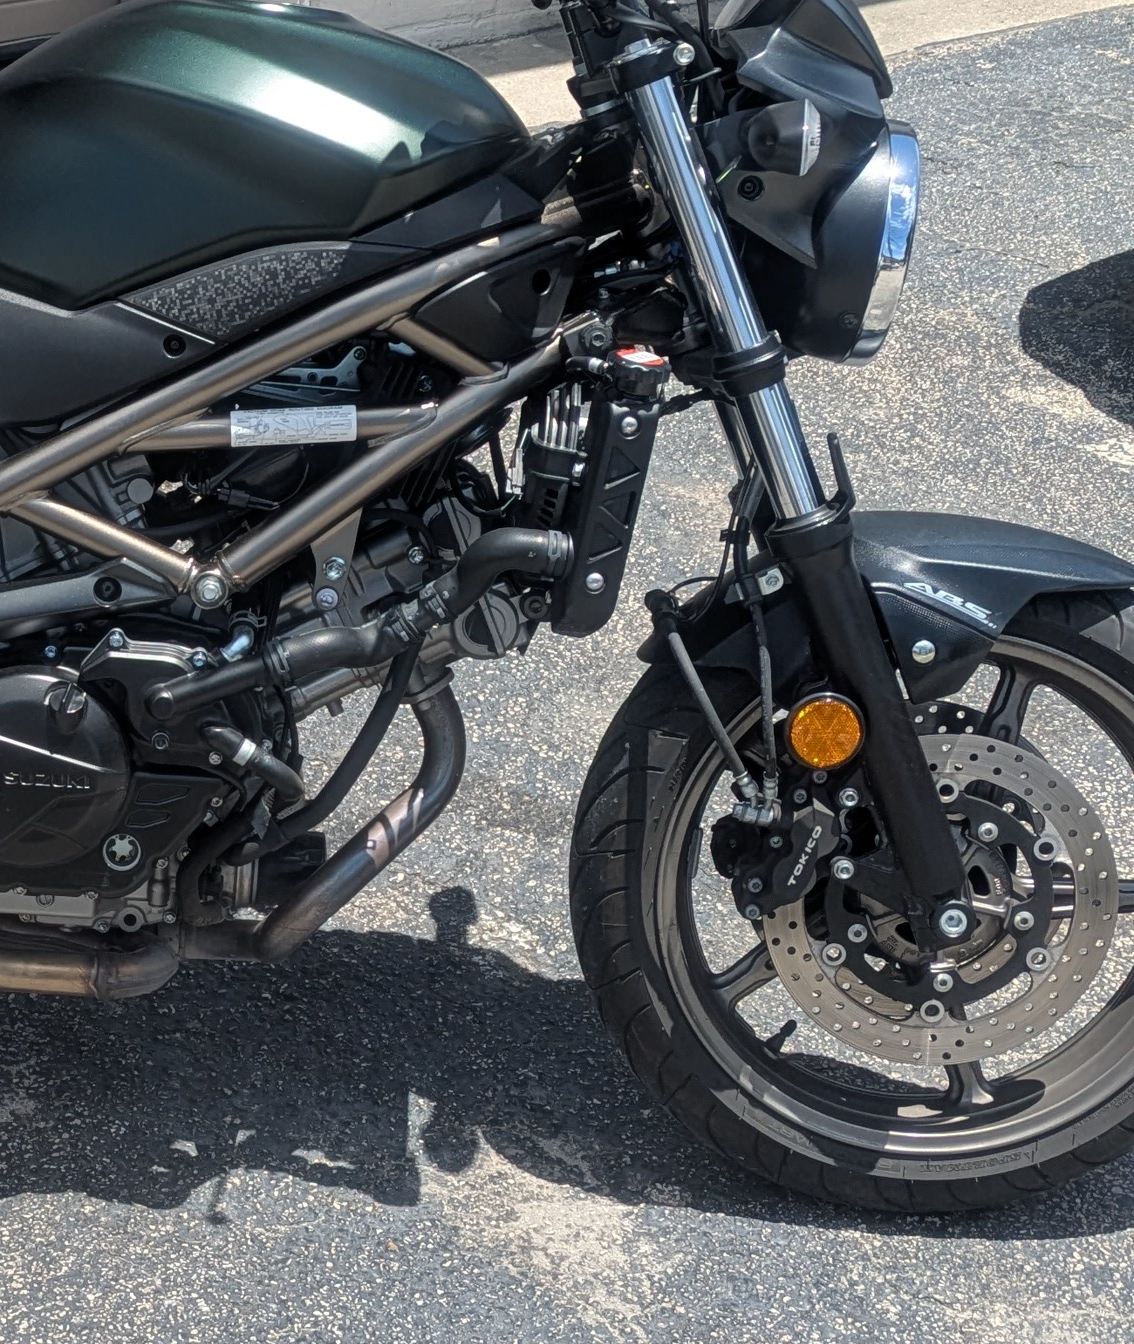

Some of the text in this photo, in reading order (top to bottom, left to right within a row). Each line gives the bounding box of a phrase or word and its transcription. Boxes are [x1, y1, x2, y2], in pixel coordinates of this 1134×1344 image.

[903, 582, 993, 620] ABS
[3, 770, 91, 790] SUZUKI
[787, 825, 823, 887] TOKICO
